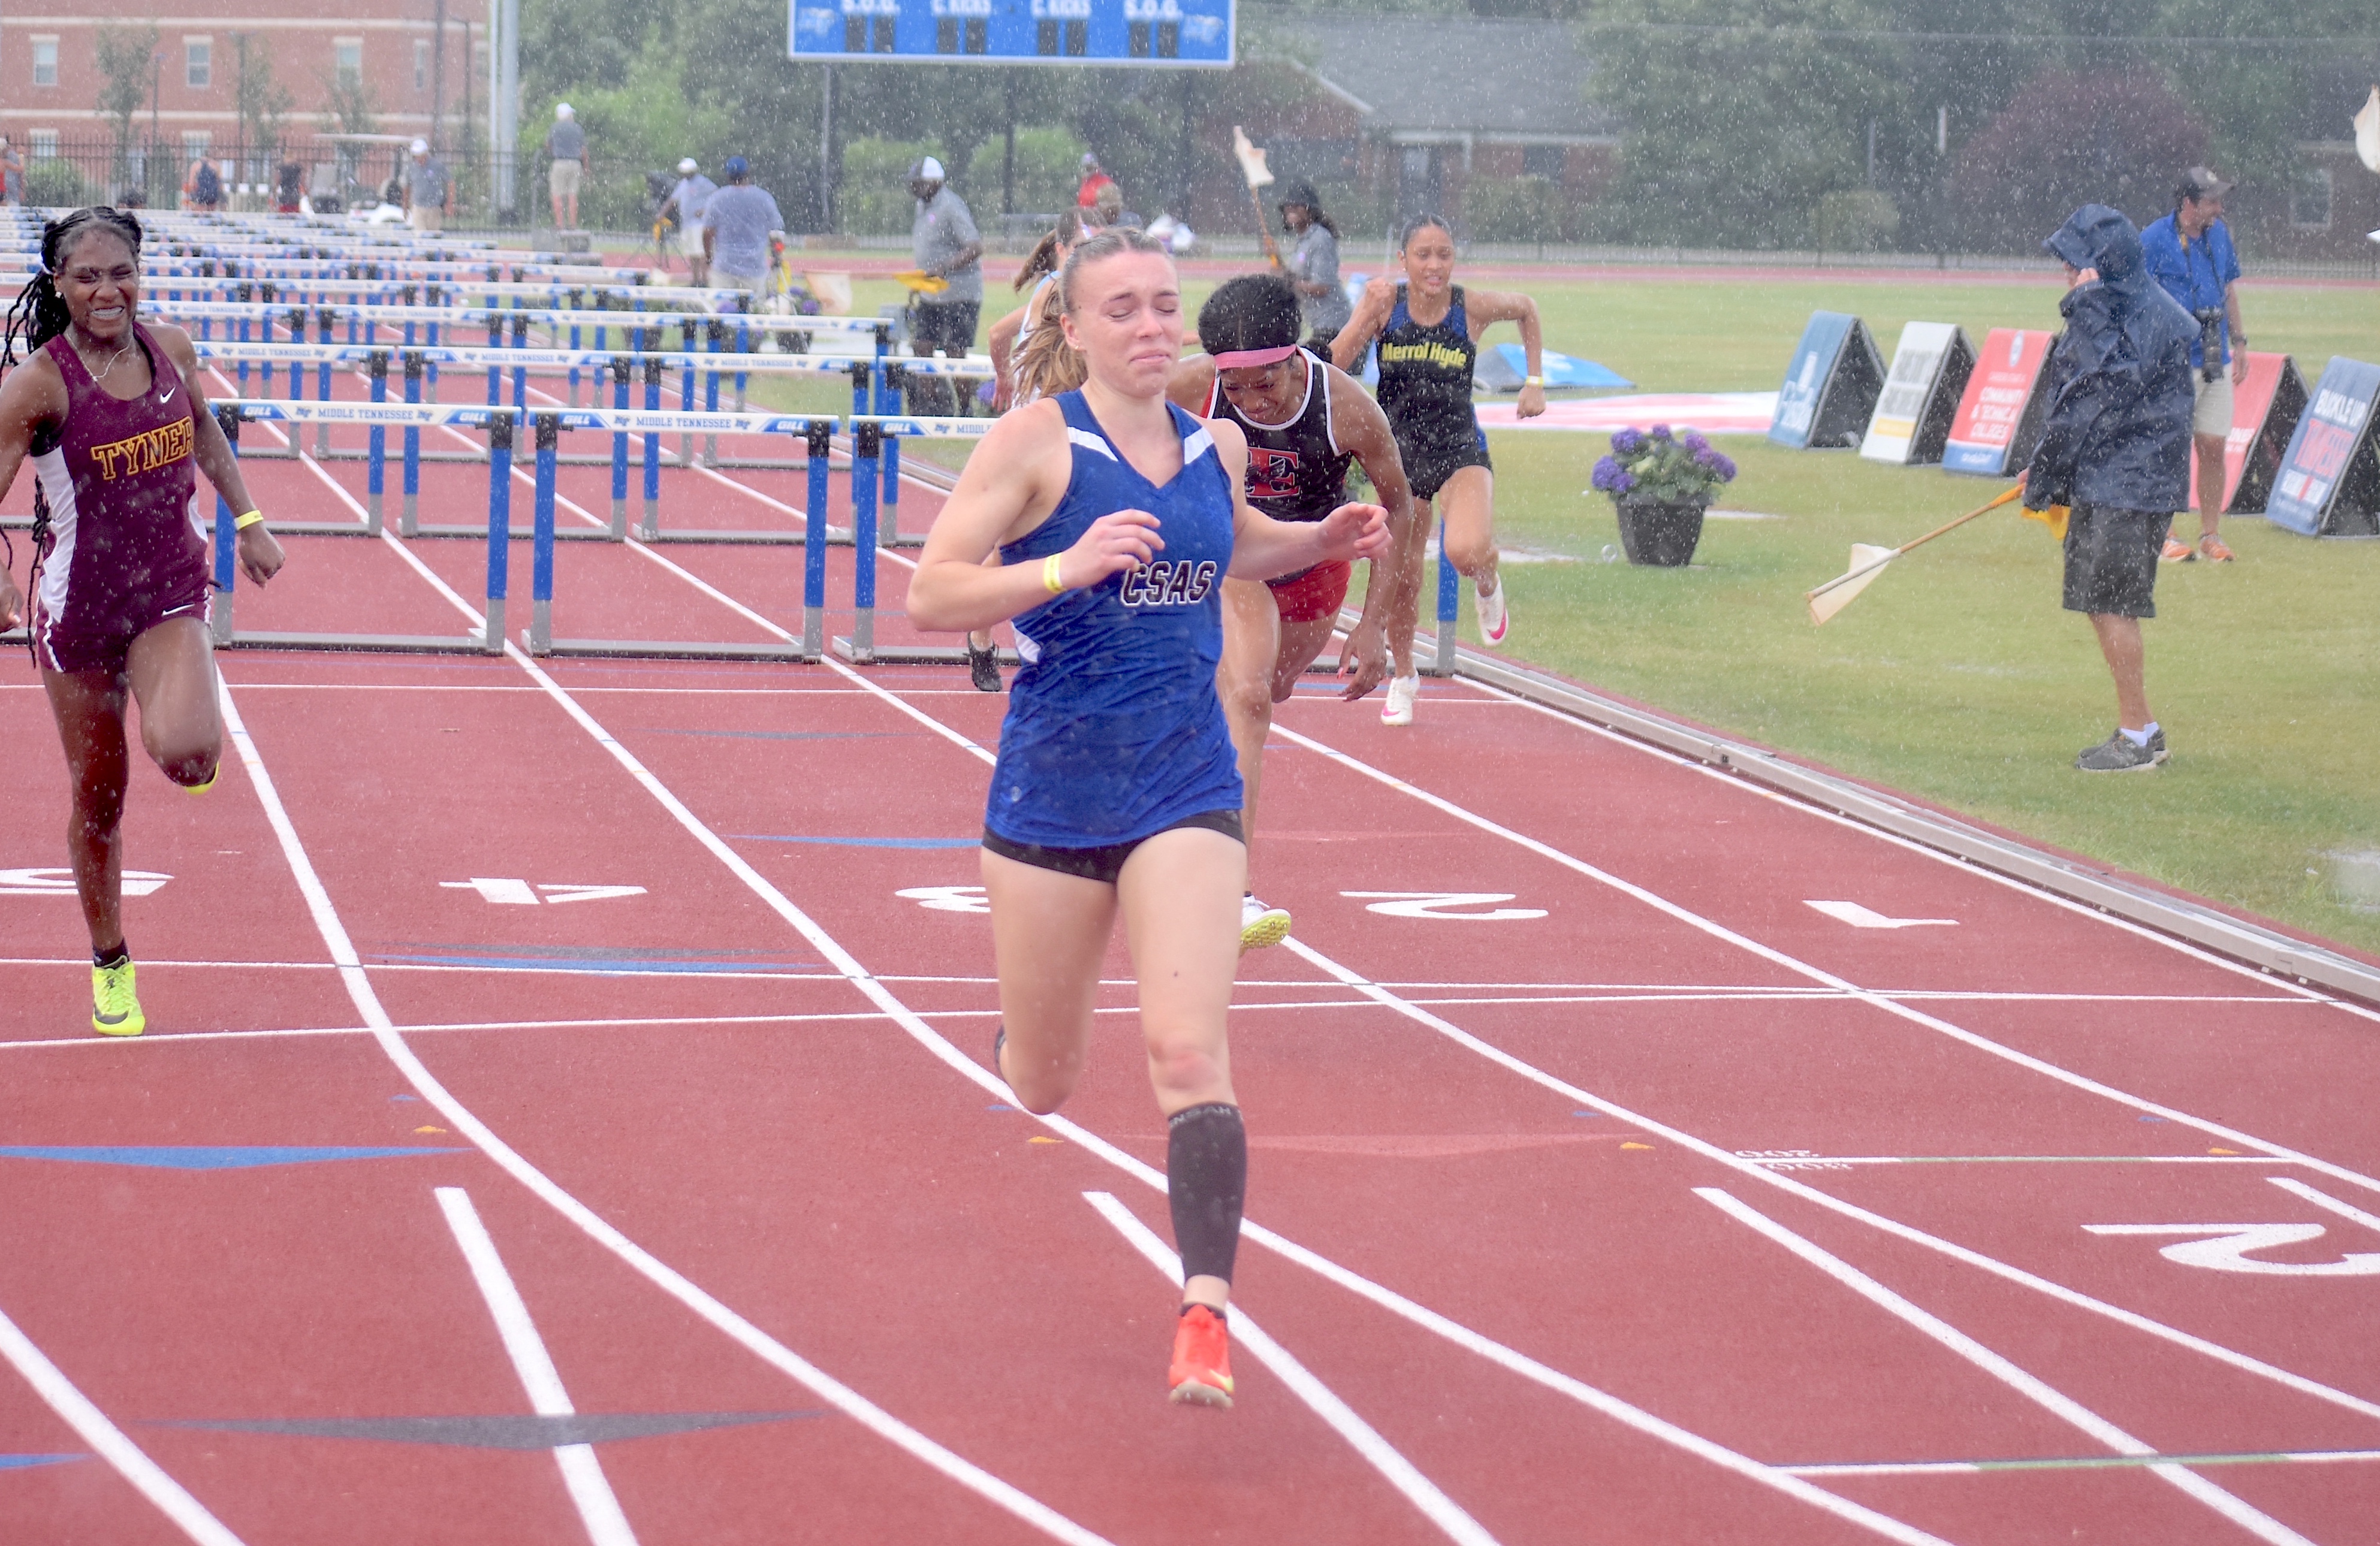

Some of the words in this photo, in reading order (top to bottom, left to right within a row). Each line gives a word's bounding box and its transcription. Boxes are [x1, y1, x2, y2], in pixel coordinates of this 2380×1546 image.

[1383, 342, 1430, 362] Merrol
[1429, 342, 1467, 369] Hyde
[244, 406, 272, 416] GILL
[318, 408, 354, 418] MIDDLE
[358, 409, 413, 419] TENNESSEE
[459, 412, 486, 422] GILL
[563, 414, 590, 424] GILL
[637, 416, 672, 426] MIDDLE
[677, 418, 731, 428] TENNESSEE
[777, 421, 804, 430] GILL
[884, 422, 911, 431] GILL
[91, 416, 194, 480] TYNER
[1121, 560, 1218, 606] CSAS
[1340, 891, 1549, 920] 2
[2080, 1224, 2380, 1275] 2
